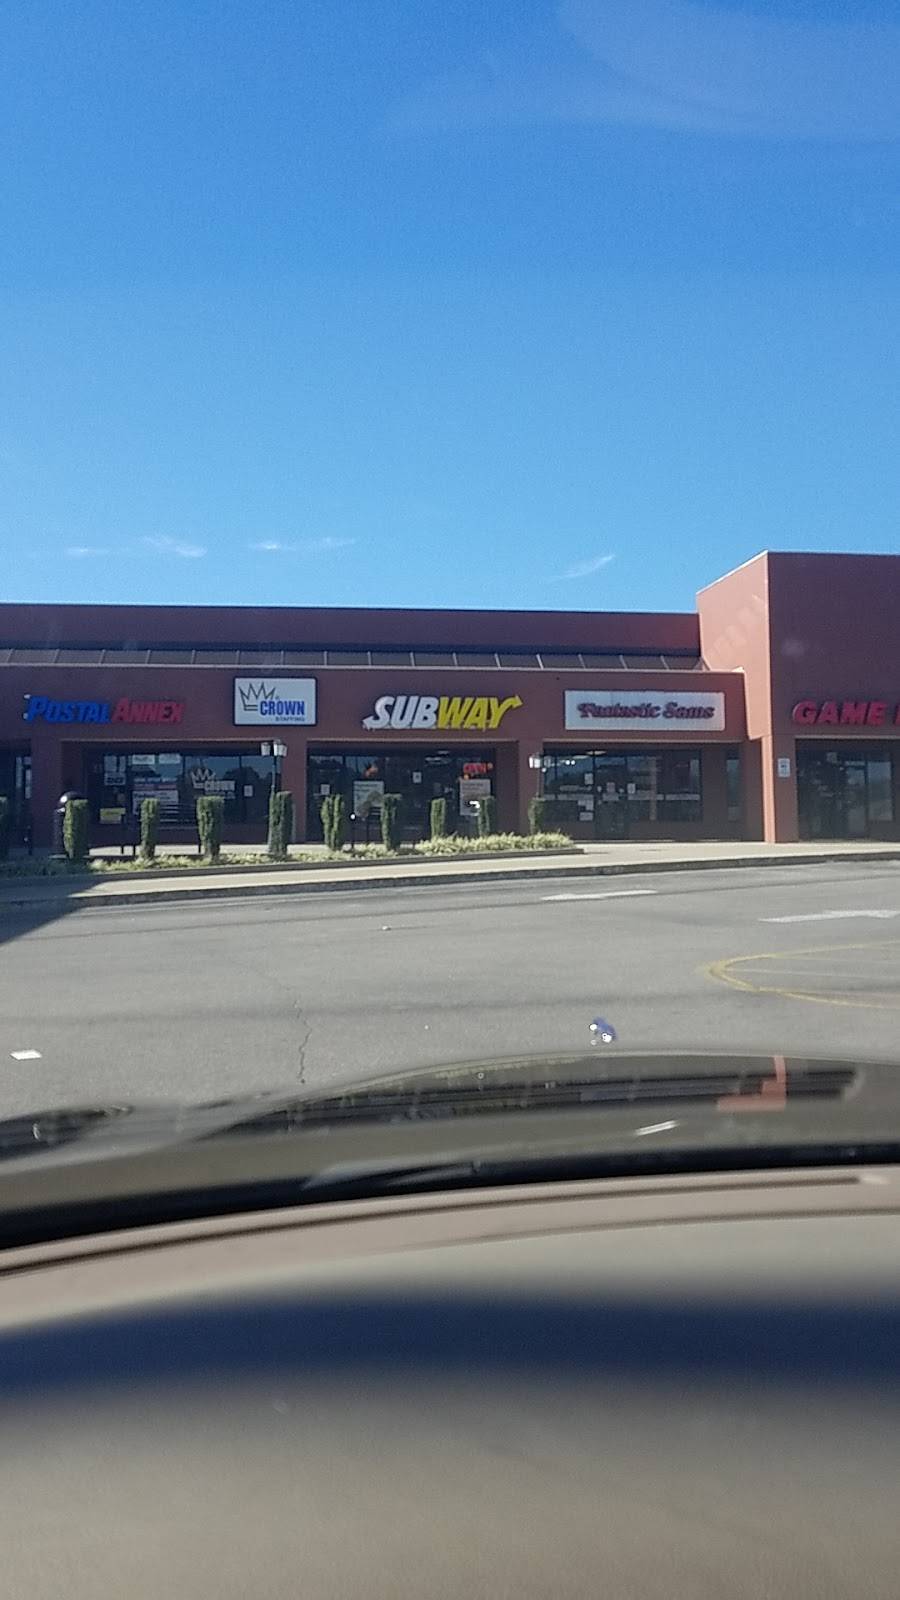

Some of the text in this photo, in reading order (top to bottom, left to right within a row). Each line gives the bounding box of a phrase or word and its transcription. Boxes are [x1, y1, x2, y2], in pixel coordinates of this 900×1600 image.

[112, 698, 186, 723] ANNEX
[260, 700, 305, 716] CROWN
[362, 694, 523, 731] SUBWAY
[577, 701, 716, 719] Fantastic Sams
[792, 700, 887, 726] GAME
